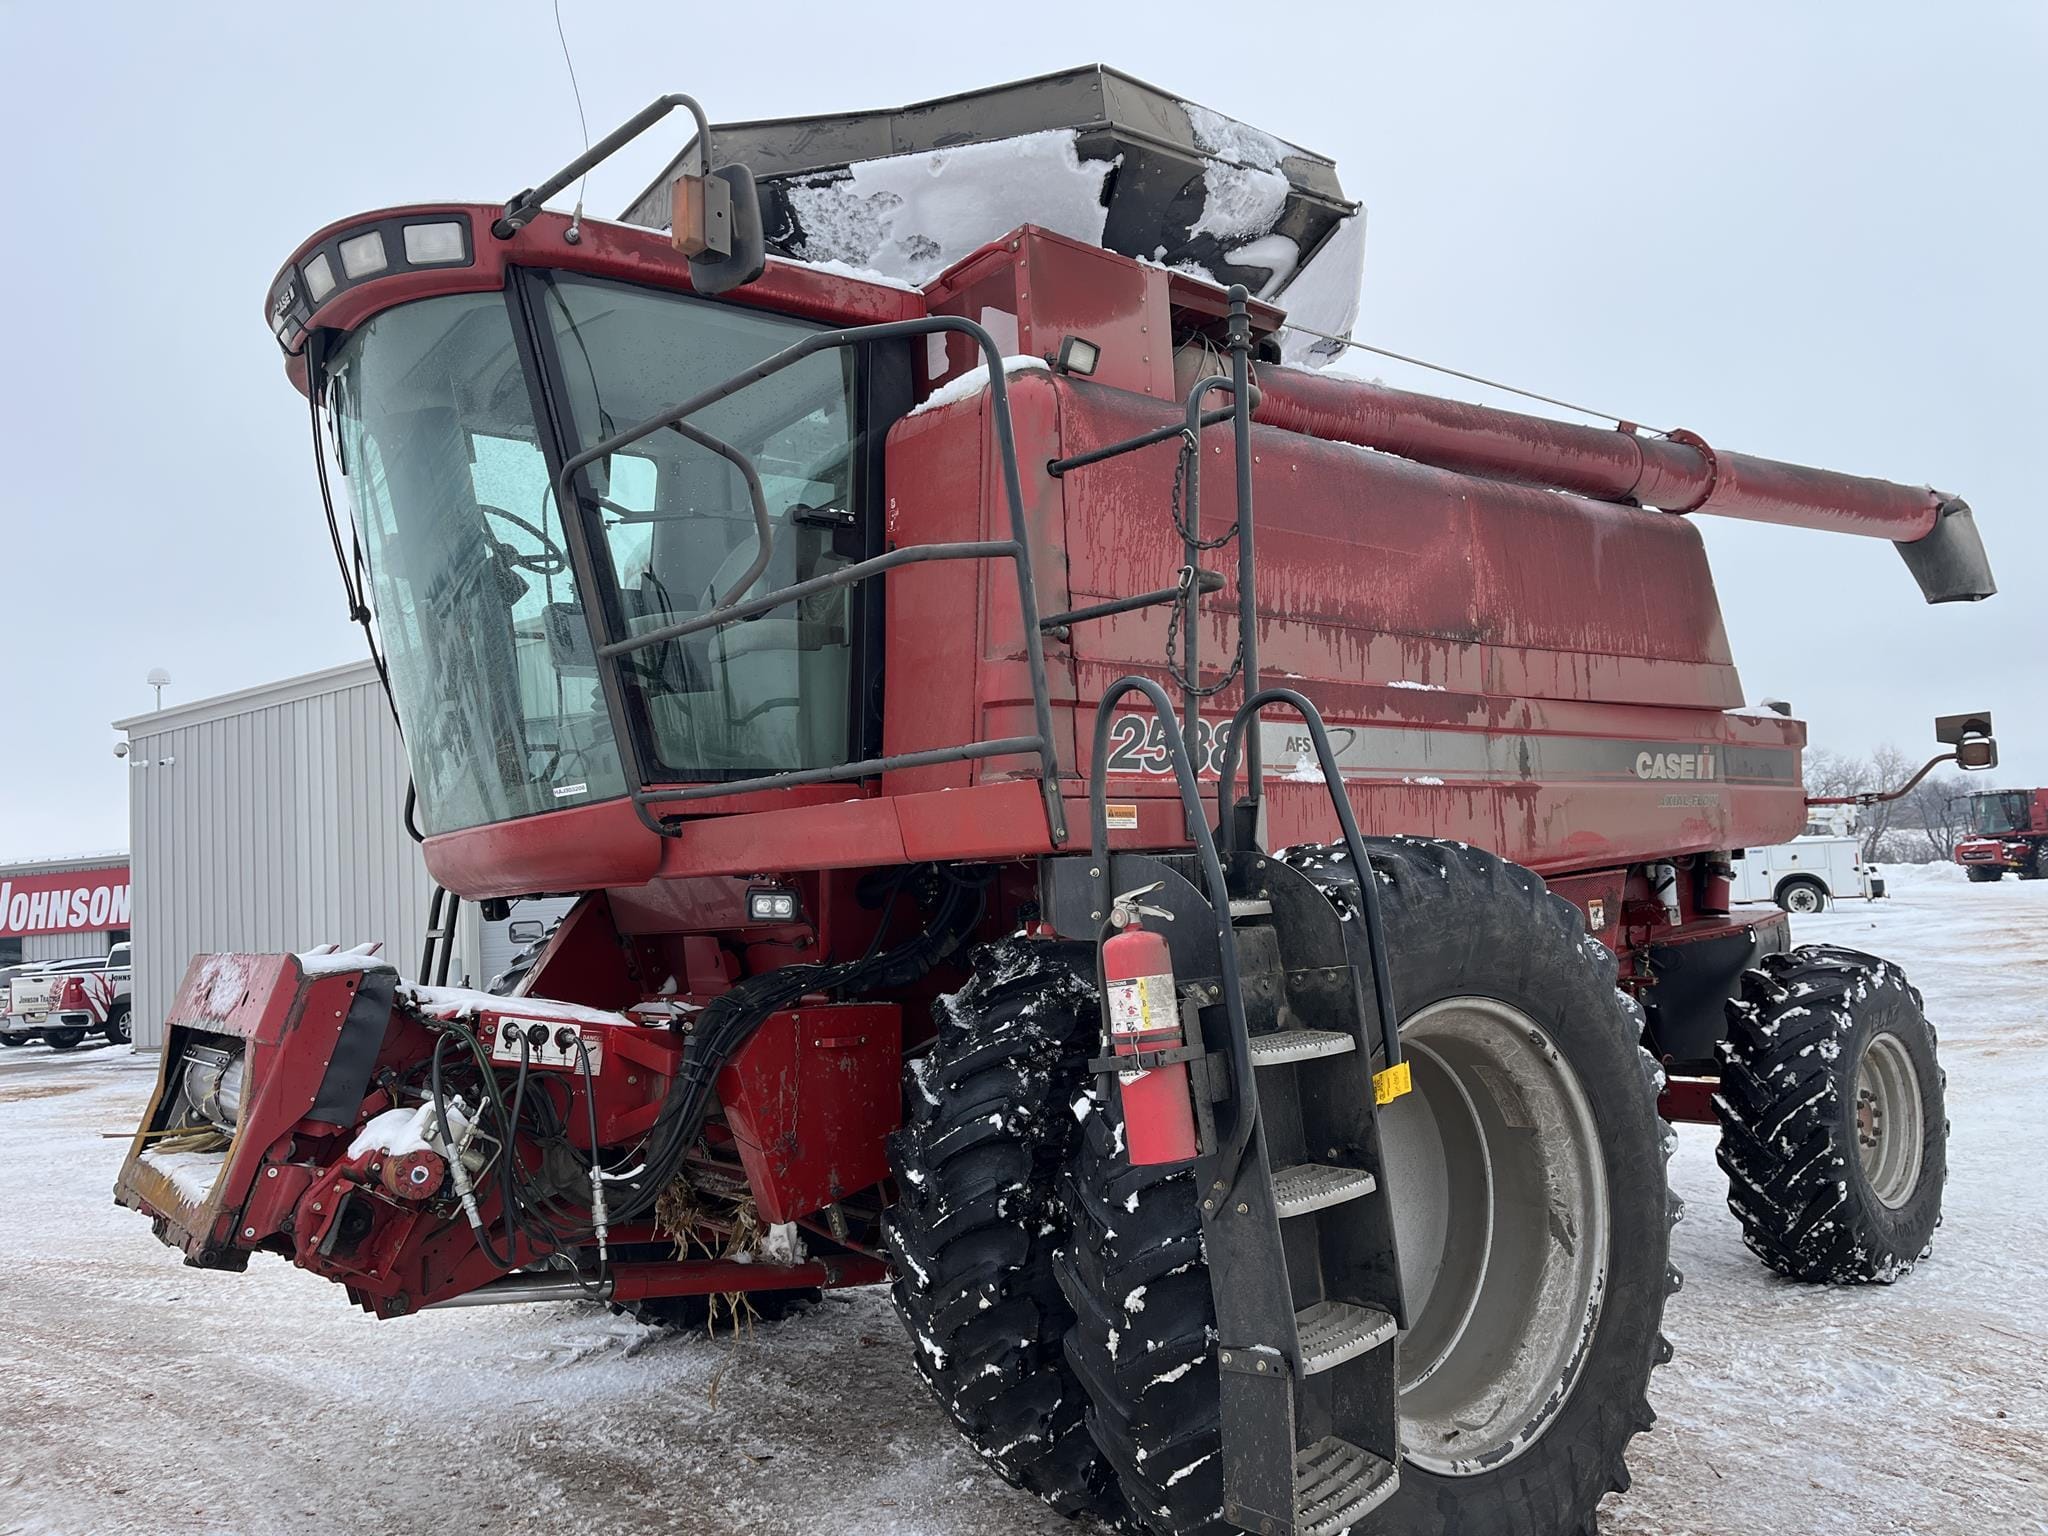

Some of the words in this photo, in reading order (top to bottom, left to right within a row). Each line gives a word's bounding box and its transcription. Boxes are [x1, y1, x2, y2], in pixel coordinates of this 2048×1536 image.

[1285, 735, 1311, 753] AFS
[1636, 751, 1695, 779] CASE
[0, 881, 131, 932] JOHNSON
